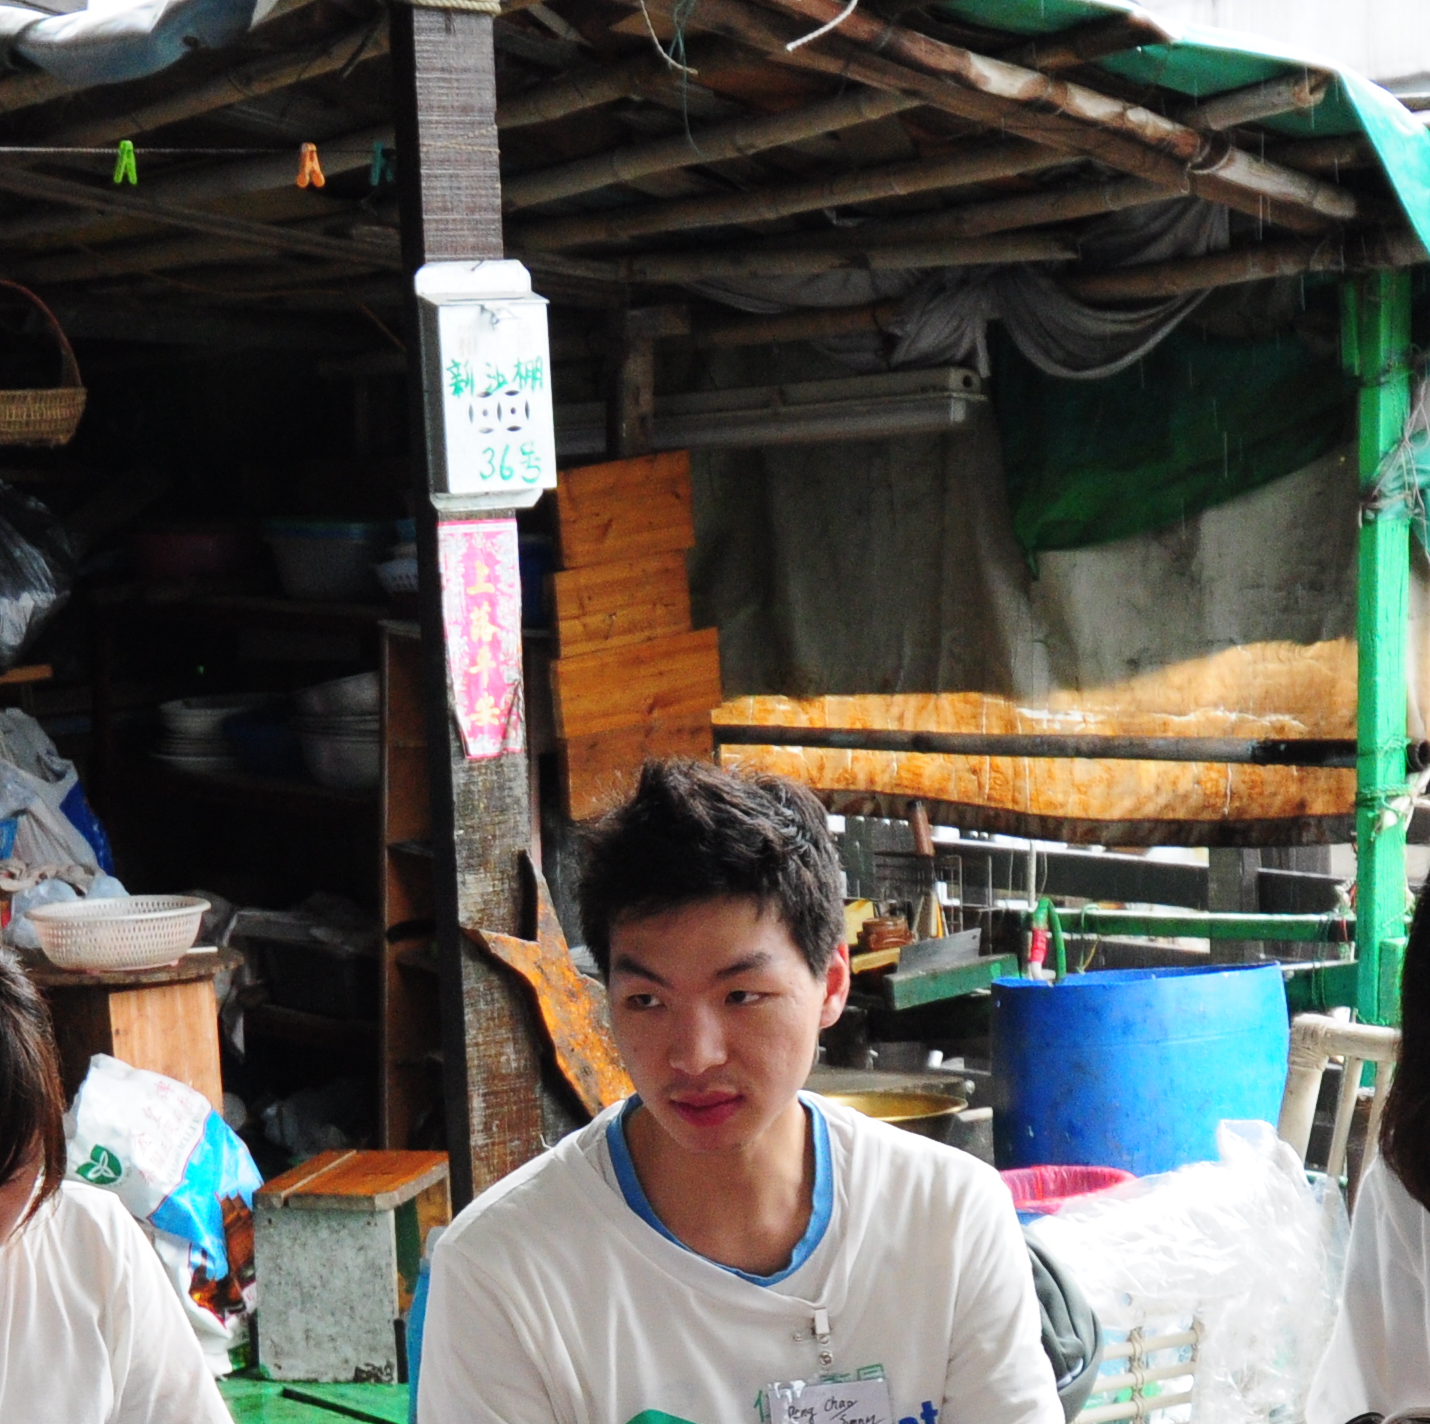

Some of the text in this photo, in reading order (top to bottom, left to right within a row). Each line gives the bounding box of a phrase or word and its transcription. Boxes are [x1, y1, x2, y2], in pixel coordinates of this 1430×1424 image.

[446, 355, 545, 398] 新沙棚
[479, 440, 543, 484] 36号
[466, 560, 502, 727] 上落平安
